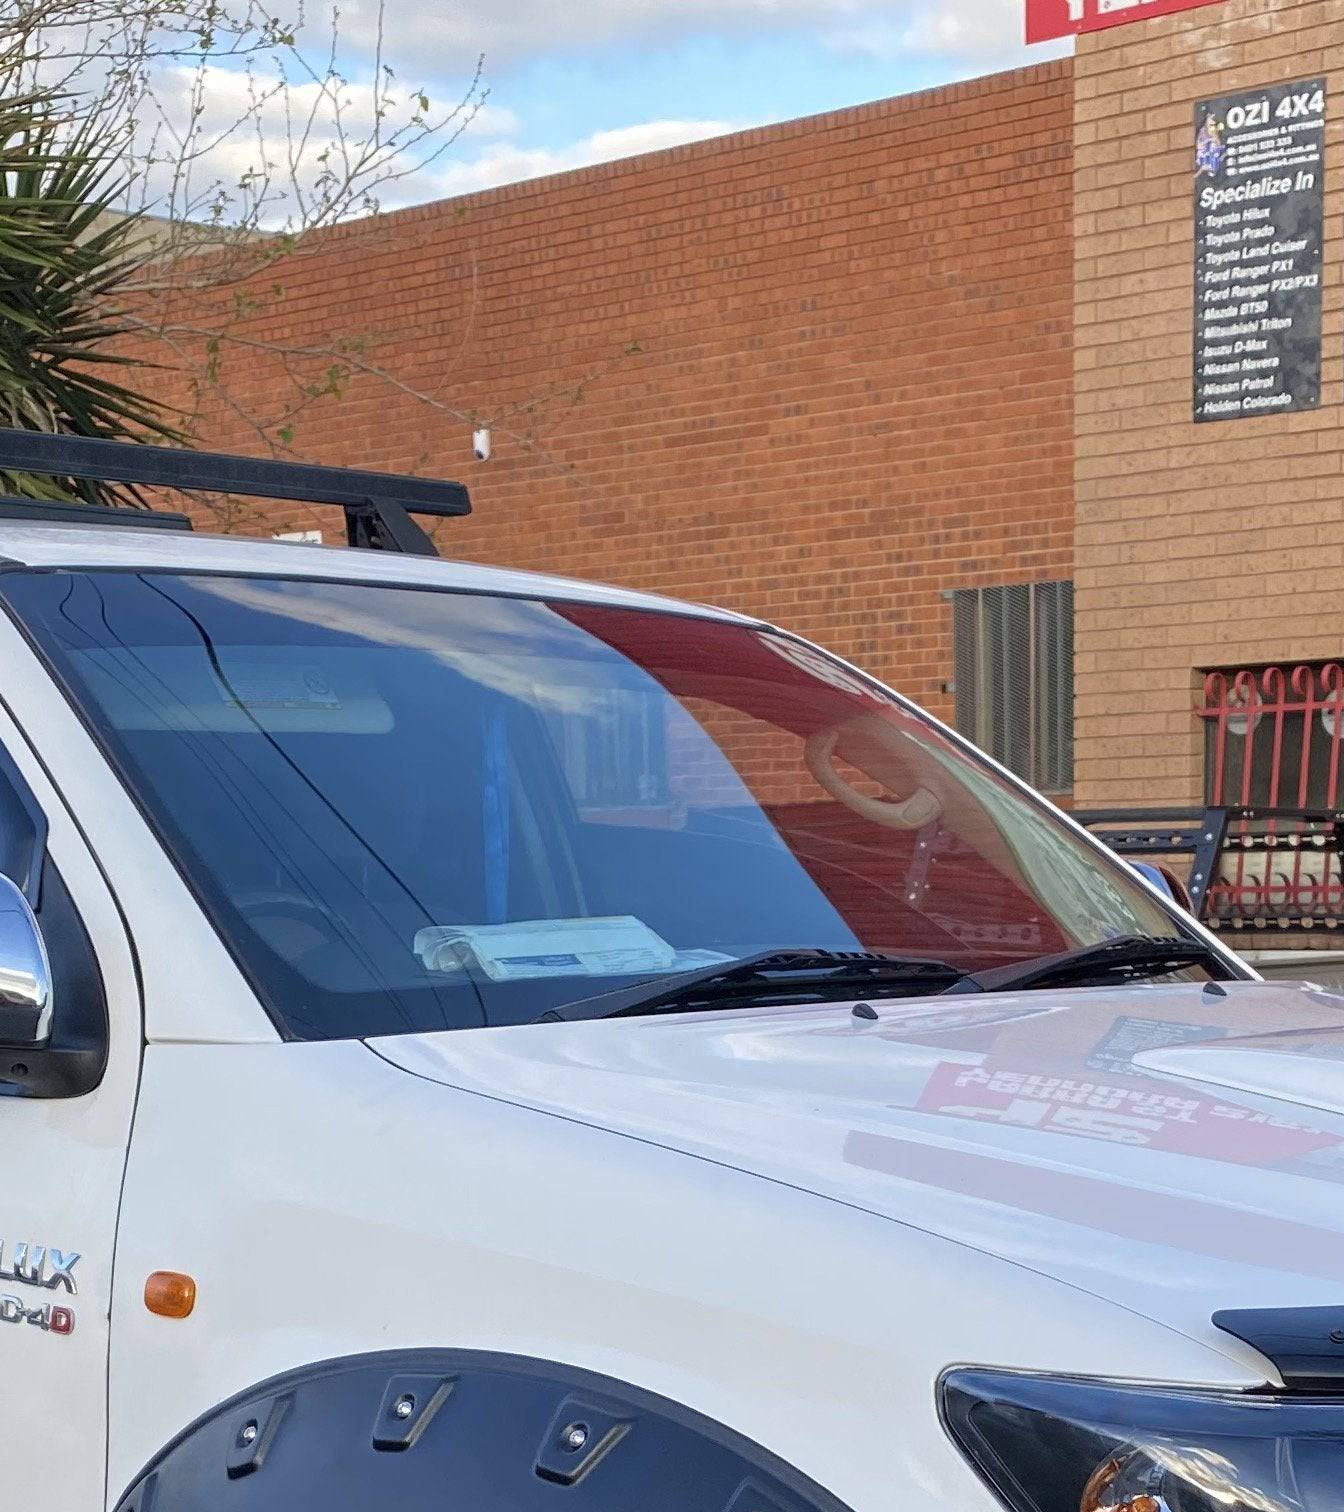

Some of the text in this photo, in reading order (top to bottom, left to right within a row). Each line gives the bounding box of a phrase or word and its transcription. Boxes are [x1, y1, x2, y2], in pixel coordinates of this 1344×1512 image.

[1226, 90, 1325, 129] OZI 4X4
[1199, 176, 1293, 210] Specialize
[1205, 207, 1271, 229] Toyota Hilux
[1205, 224, 1275, 247] Toyota Prado
[1205, 249, 1241, 266] Toyota
[1242, 243, 1271, 259] Land
[1203, 268, 1231, 283] Ford
[1231, 264, 1271, 279] Ranger
[1203, 287, 1230, 302] Ford
[1231, 283, 1271, 298] Ranger
[1203, 305, 1238, 320] Mazda
[1260, 317, 1292, 331] Triton
[1203, 339, 1268, 357] Isuzu D-Max
[1203, 362, 1240, 376] Nissan
[1203, 375, 1274, 396] Nissan Patrol
[1203, 392, 1292, 414] Holden Colorado
[0, 1293, 76, 1336] D-4D
